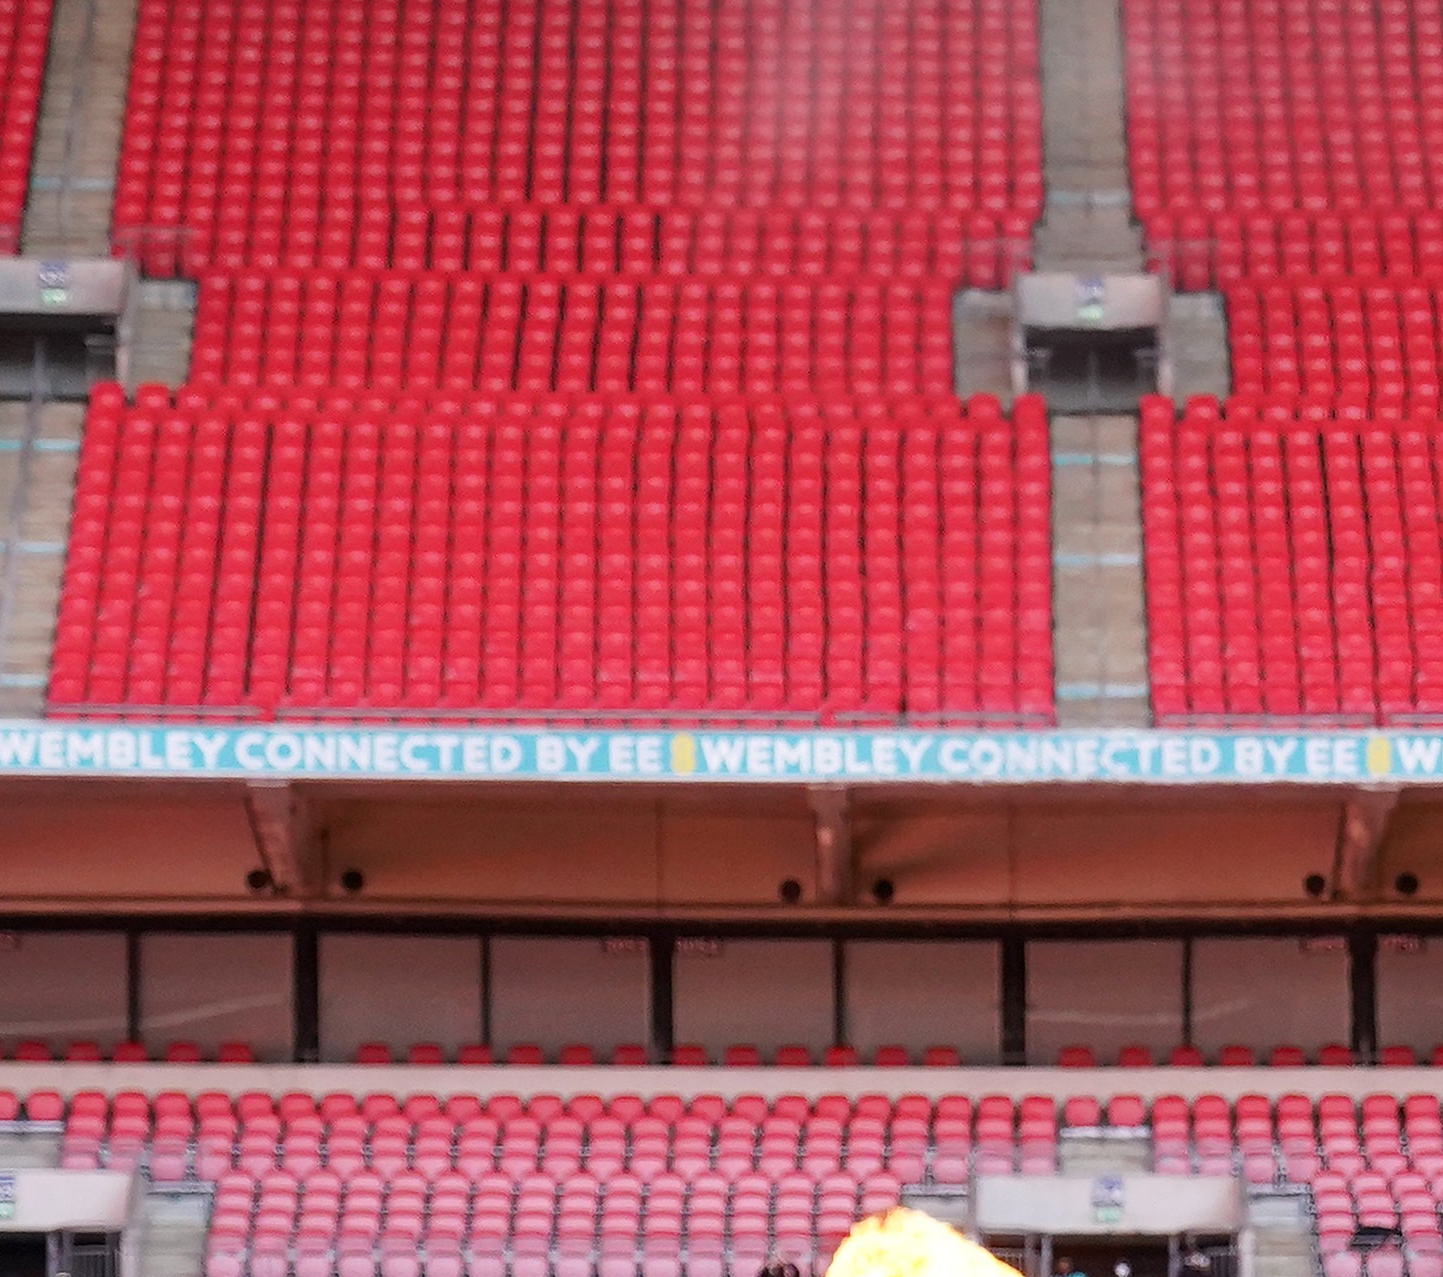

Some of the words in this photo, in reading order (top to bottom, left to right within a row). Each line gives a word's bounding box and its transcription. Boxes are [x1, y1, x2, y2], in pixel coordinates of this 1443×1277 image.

[236, 733, 526, 773] CONNECTED
[537, 735, 599, 773] BY
[611, 737, 662, 773] EE
[705, 737, 933, 774] WEMBLEY
[939, 738, 1219, 775] CONNECTED
[1236, 738, 1299, 775] BY
[1308, 738, 1360, 774] EE
